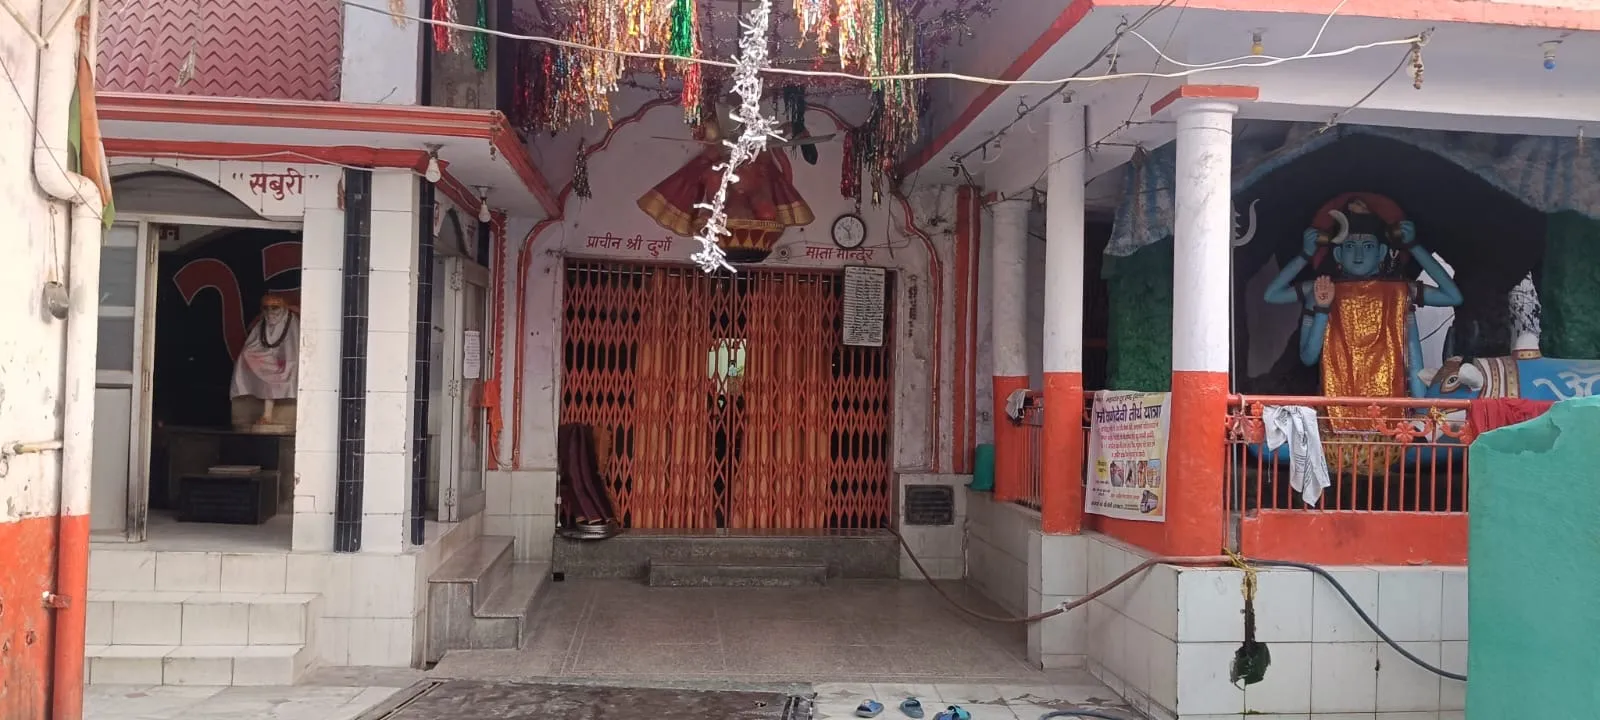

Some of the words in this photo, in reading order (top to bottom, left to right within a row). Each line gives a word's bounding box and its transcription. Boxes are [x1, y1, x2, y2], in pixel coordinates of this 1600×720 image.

[586, 232, 623, 250] प्राचीन
[626, 234, 643, 251] श्री
[806, 246, 833, 260] माता
[1143, 404, 1162, 419] यात्रा
